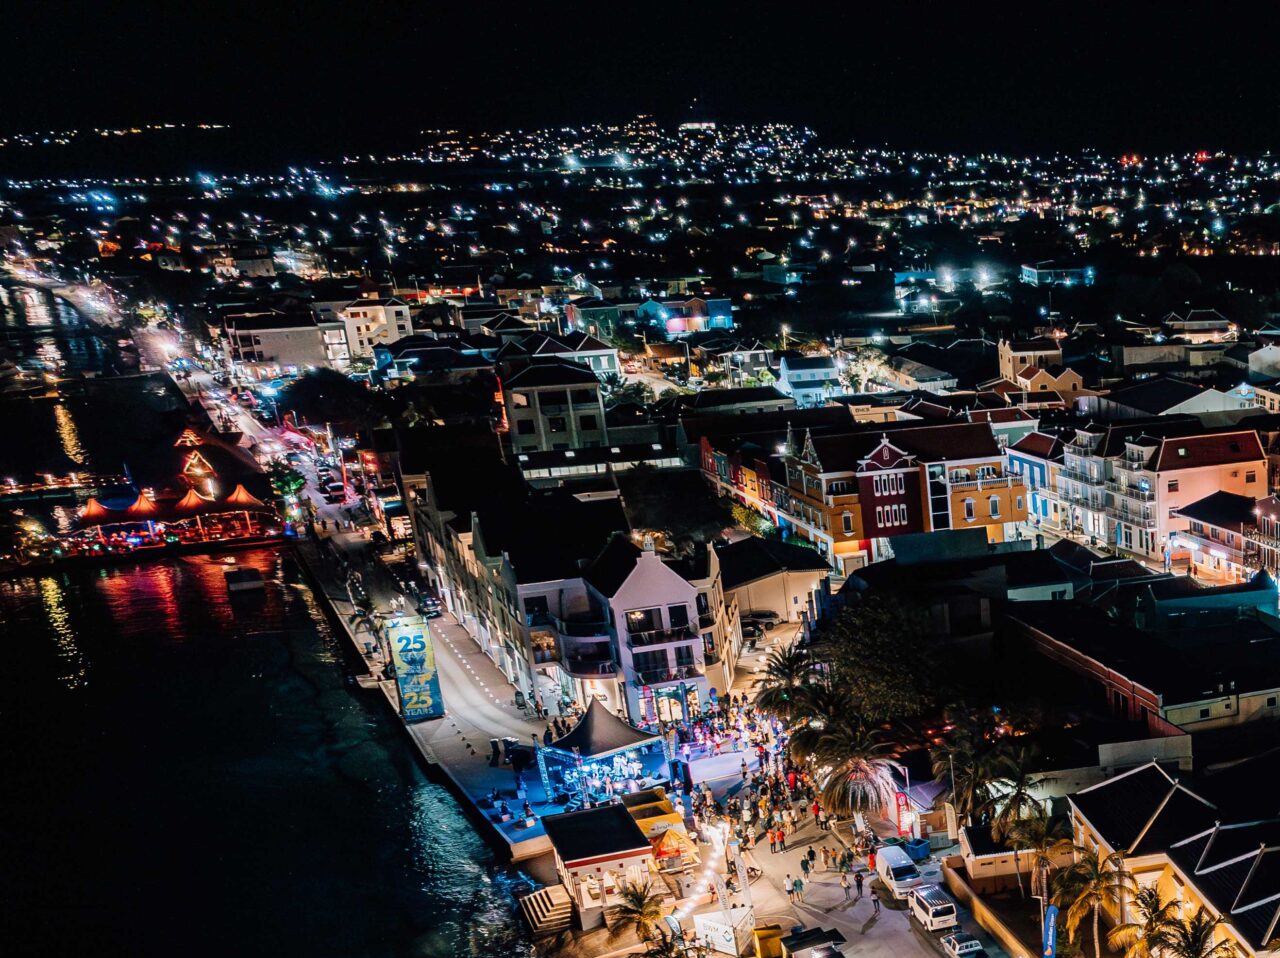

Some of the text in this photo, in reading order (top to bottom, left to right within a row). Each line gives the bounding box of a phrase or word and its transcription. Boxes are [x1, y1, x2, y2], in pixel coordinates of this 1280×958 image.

[397, 635, 426, 653] 25
[404, 691, 433, 709] 25
[405, 707, 434, 715] YEARS
